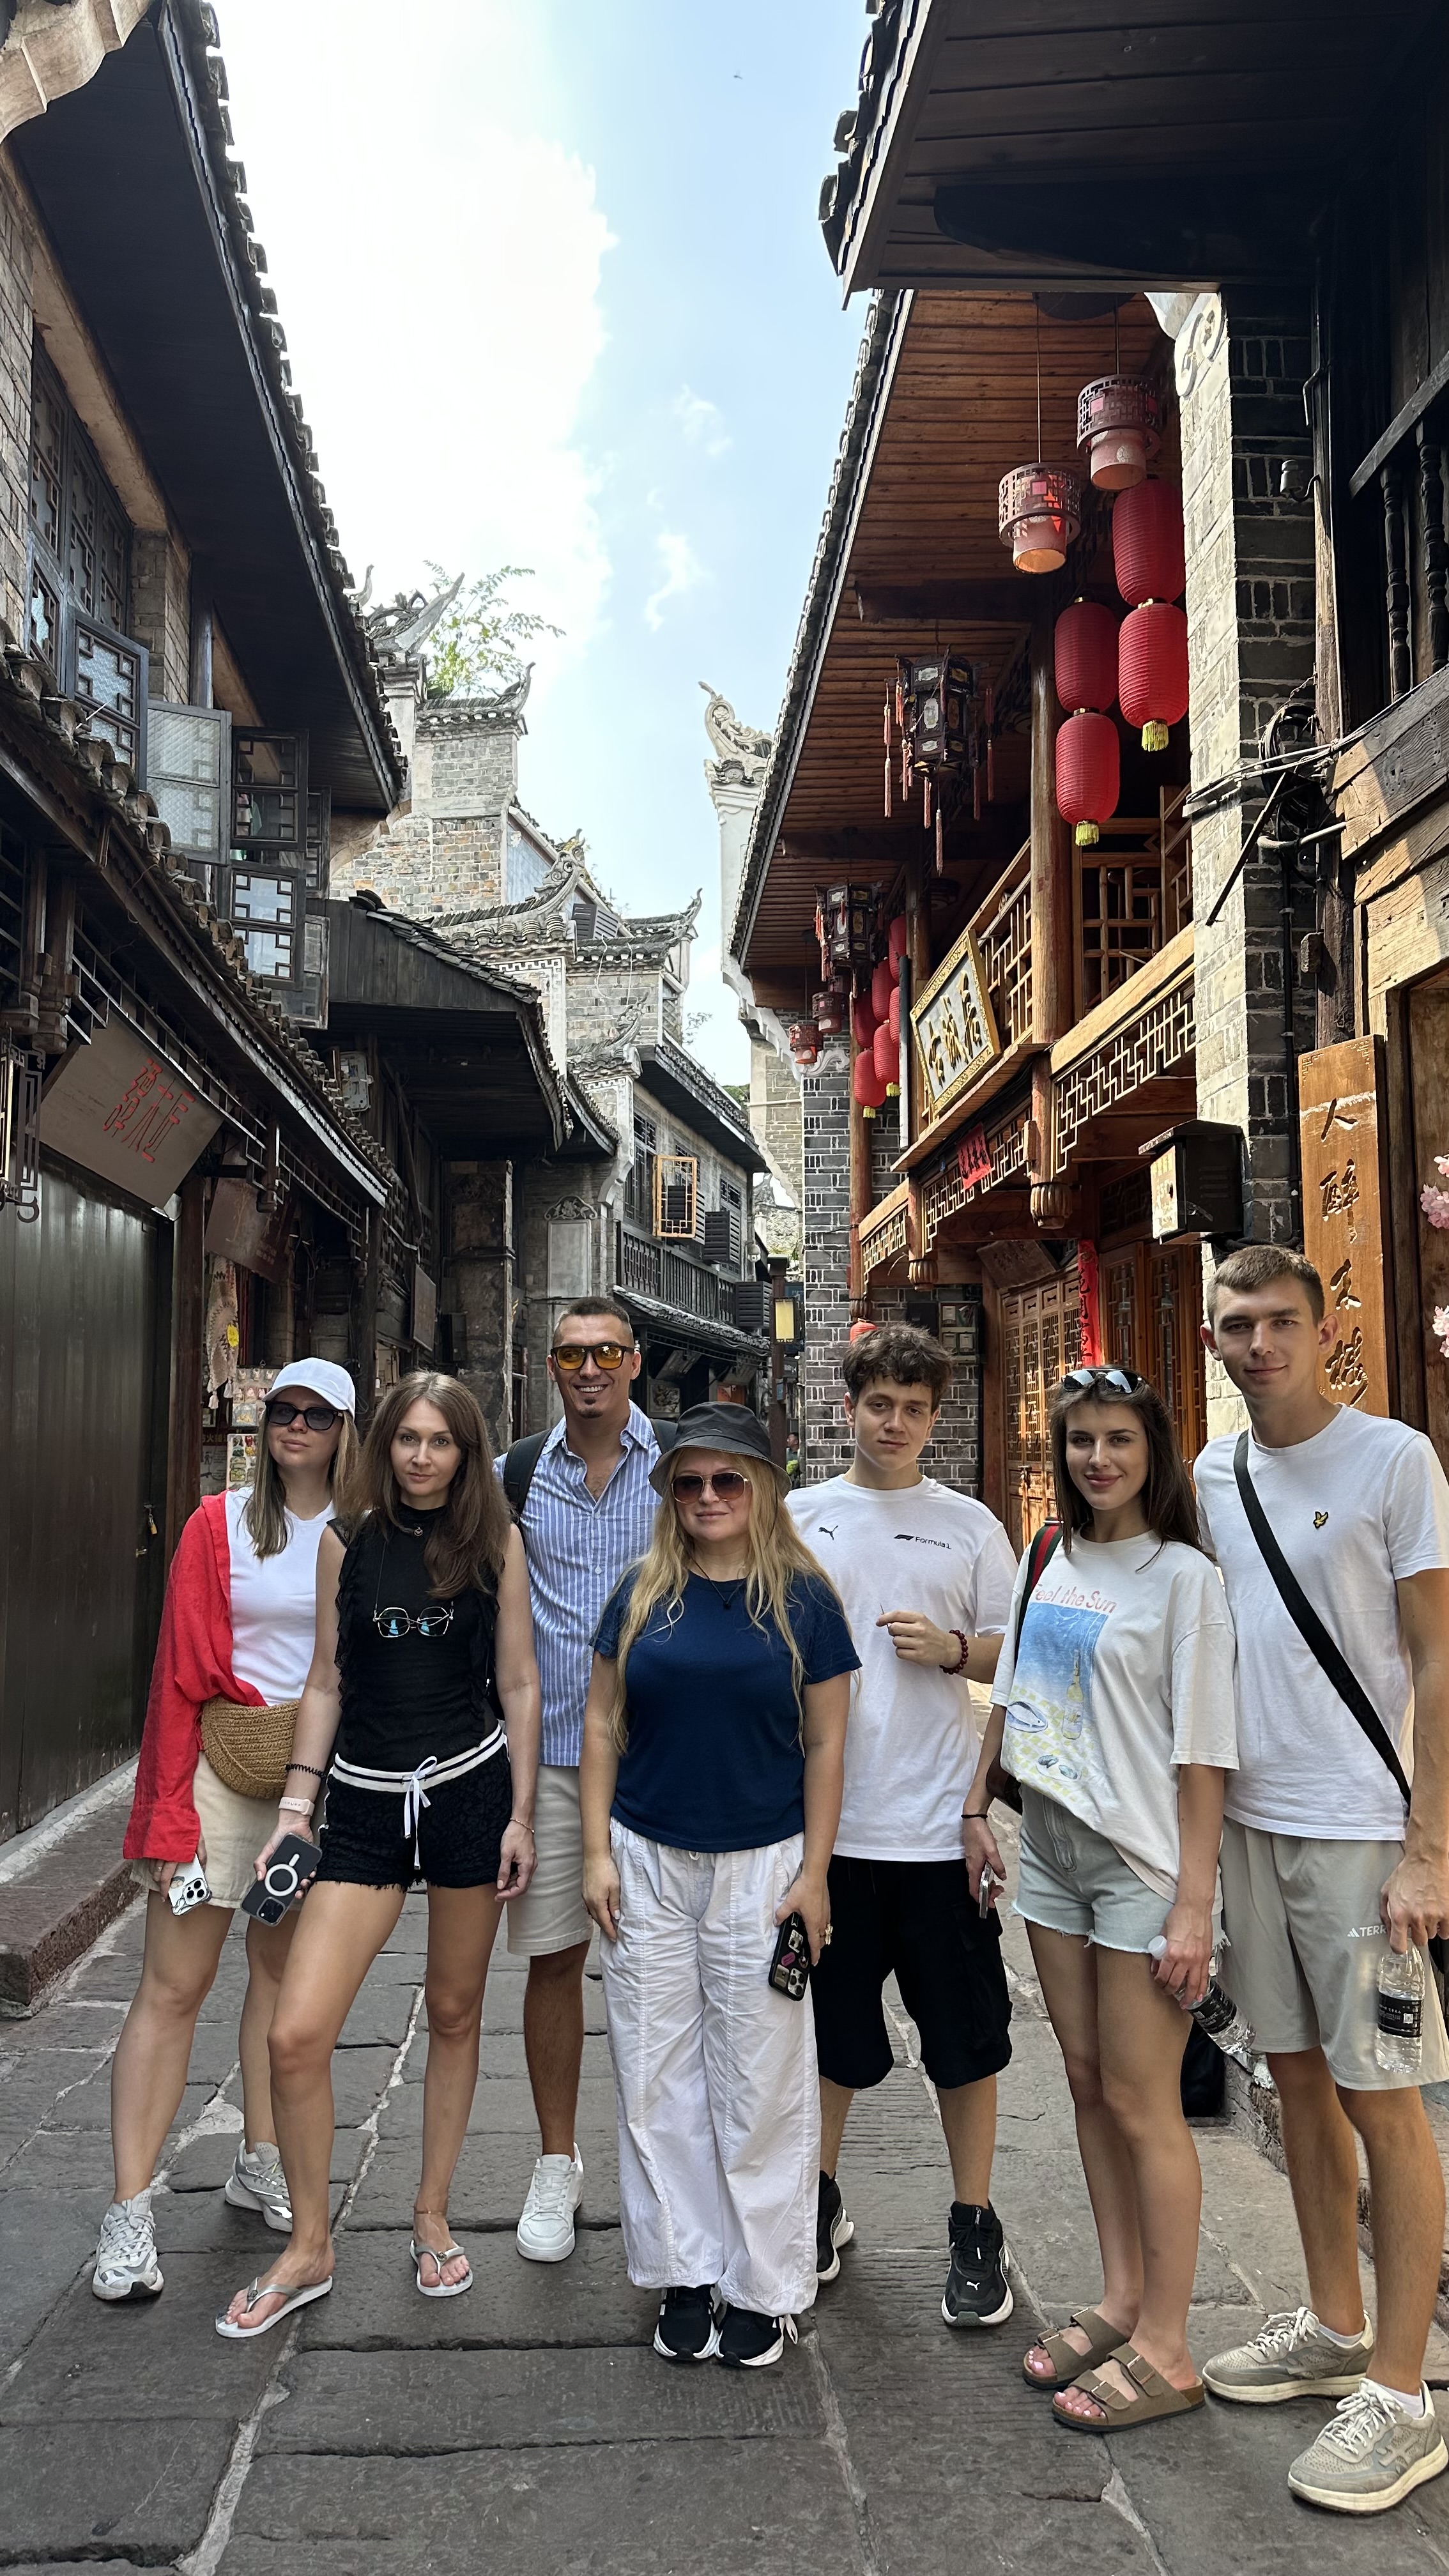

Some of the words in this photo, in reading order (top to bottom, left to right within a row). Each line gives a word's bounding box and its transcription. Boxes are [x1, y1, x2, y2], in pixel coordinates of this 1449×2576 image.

[915, 1537, 946, 1548] Formula
[1060, 1586, 1085, 1606] the
[1085, 1590, 1117, 1613] Sun
[1360, 1925, 1387, 1937] TERR
